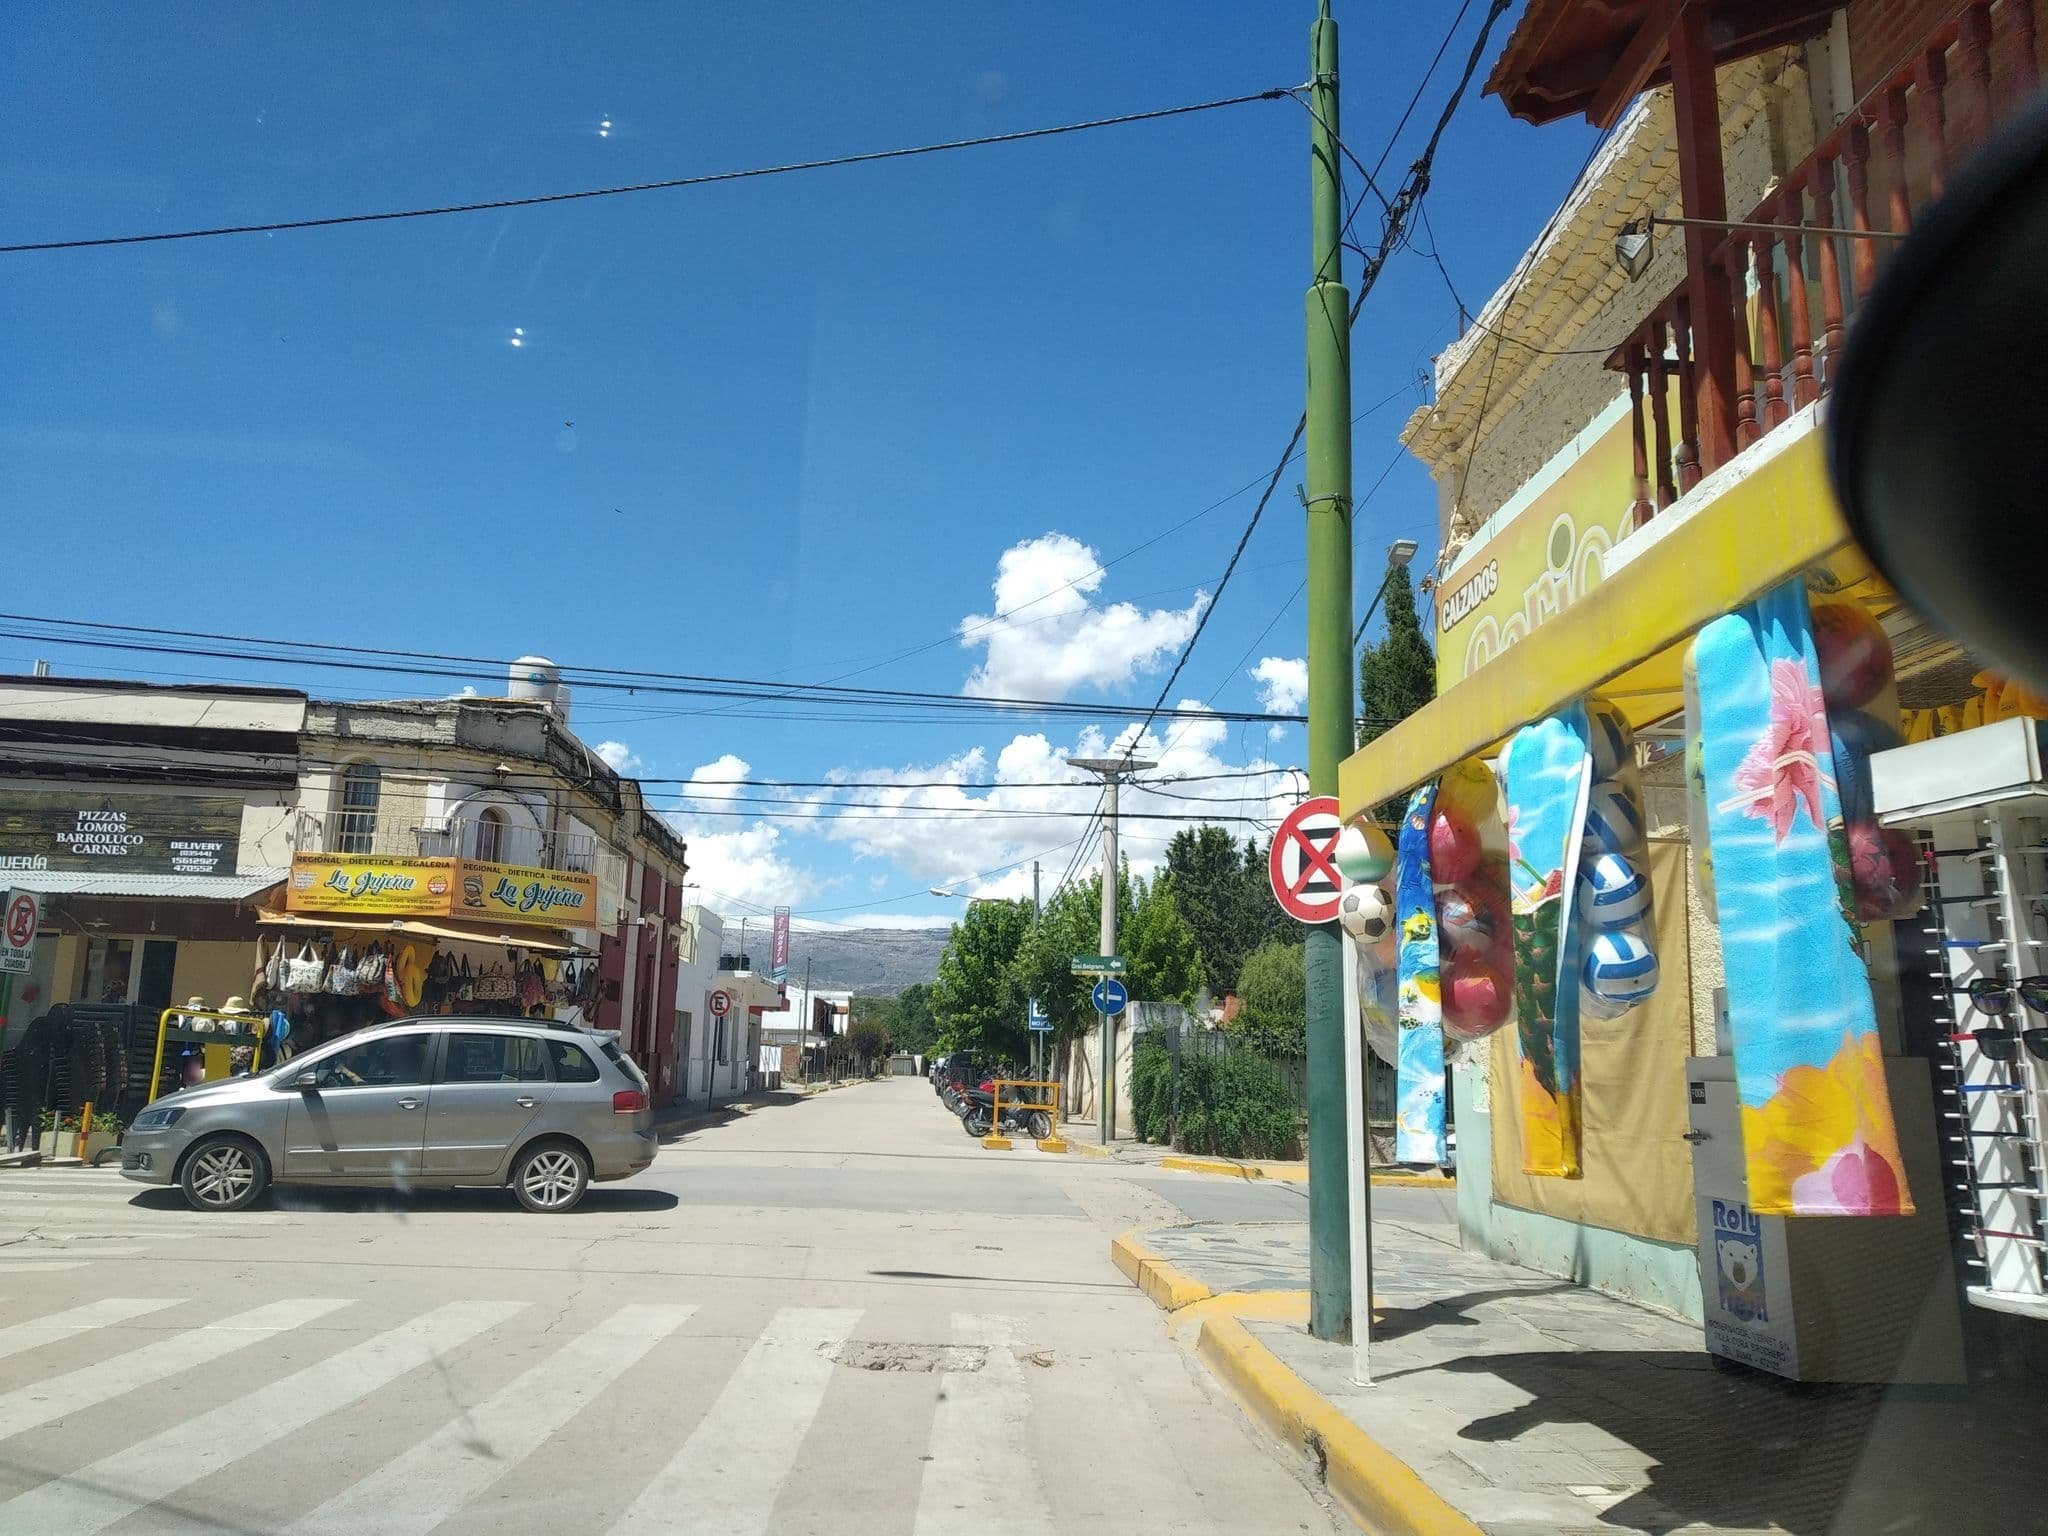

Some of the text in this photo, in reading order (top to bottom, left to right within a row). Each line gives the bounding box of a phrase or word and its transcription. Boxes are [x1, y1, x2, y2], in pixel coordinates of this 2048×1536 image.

[1442, 558, 1498, 633] CALZADOS
[78, 811, 127, 821] PIZZAS
[76, 822, 126, 833] LOMOS
[56, 832, 144, 845] BARROLUCO
[72, 843, 128, 855] CARNES
[170, 841, 223, 851] DELIVERY
[296, 855, 451, 869] REGIONAL DIETETICA REGALERIA
[463, 863, 591, 885] REGIONAL DIETETICA REGALERIA
[324, 869, 350, 893] La
[350, 871, 417, 897] Jujeña
[489, 877, 586, 912] La Jujeña
